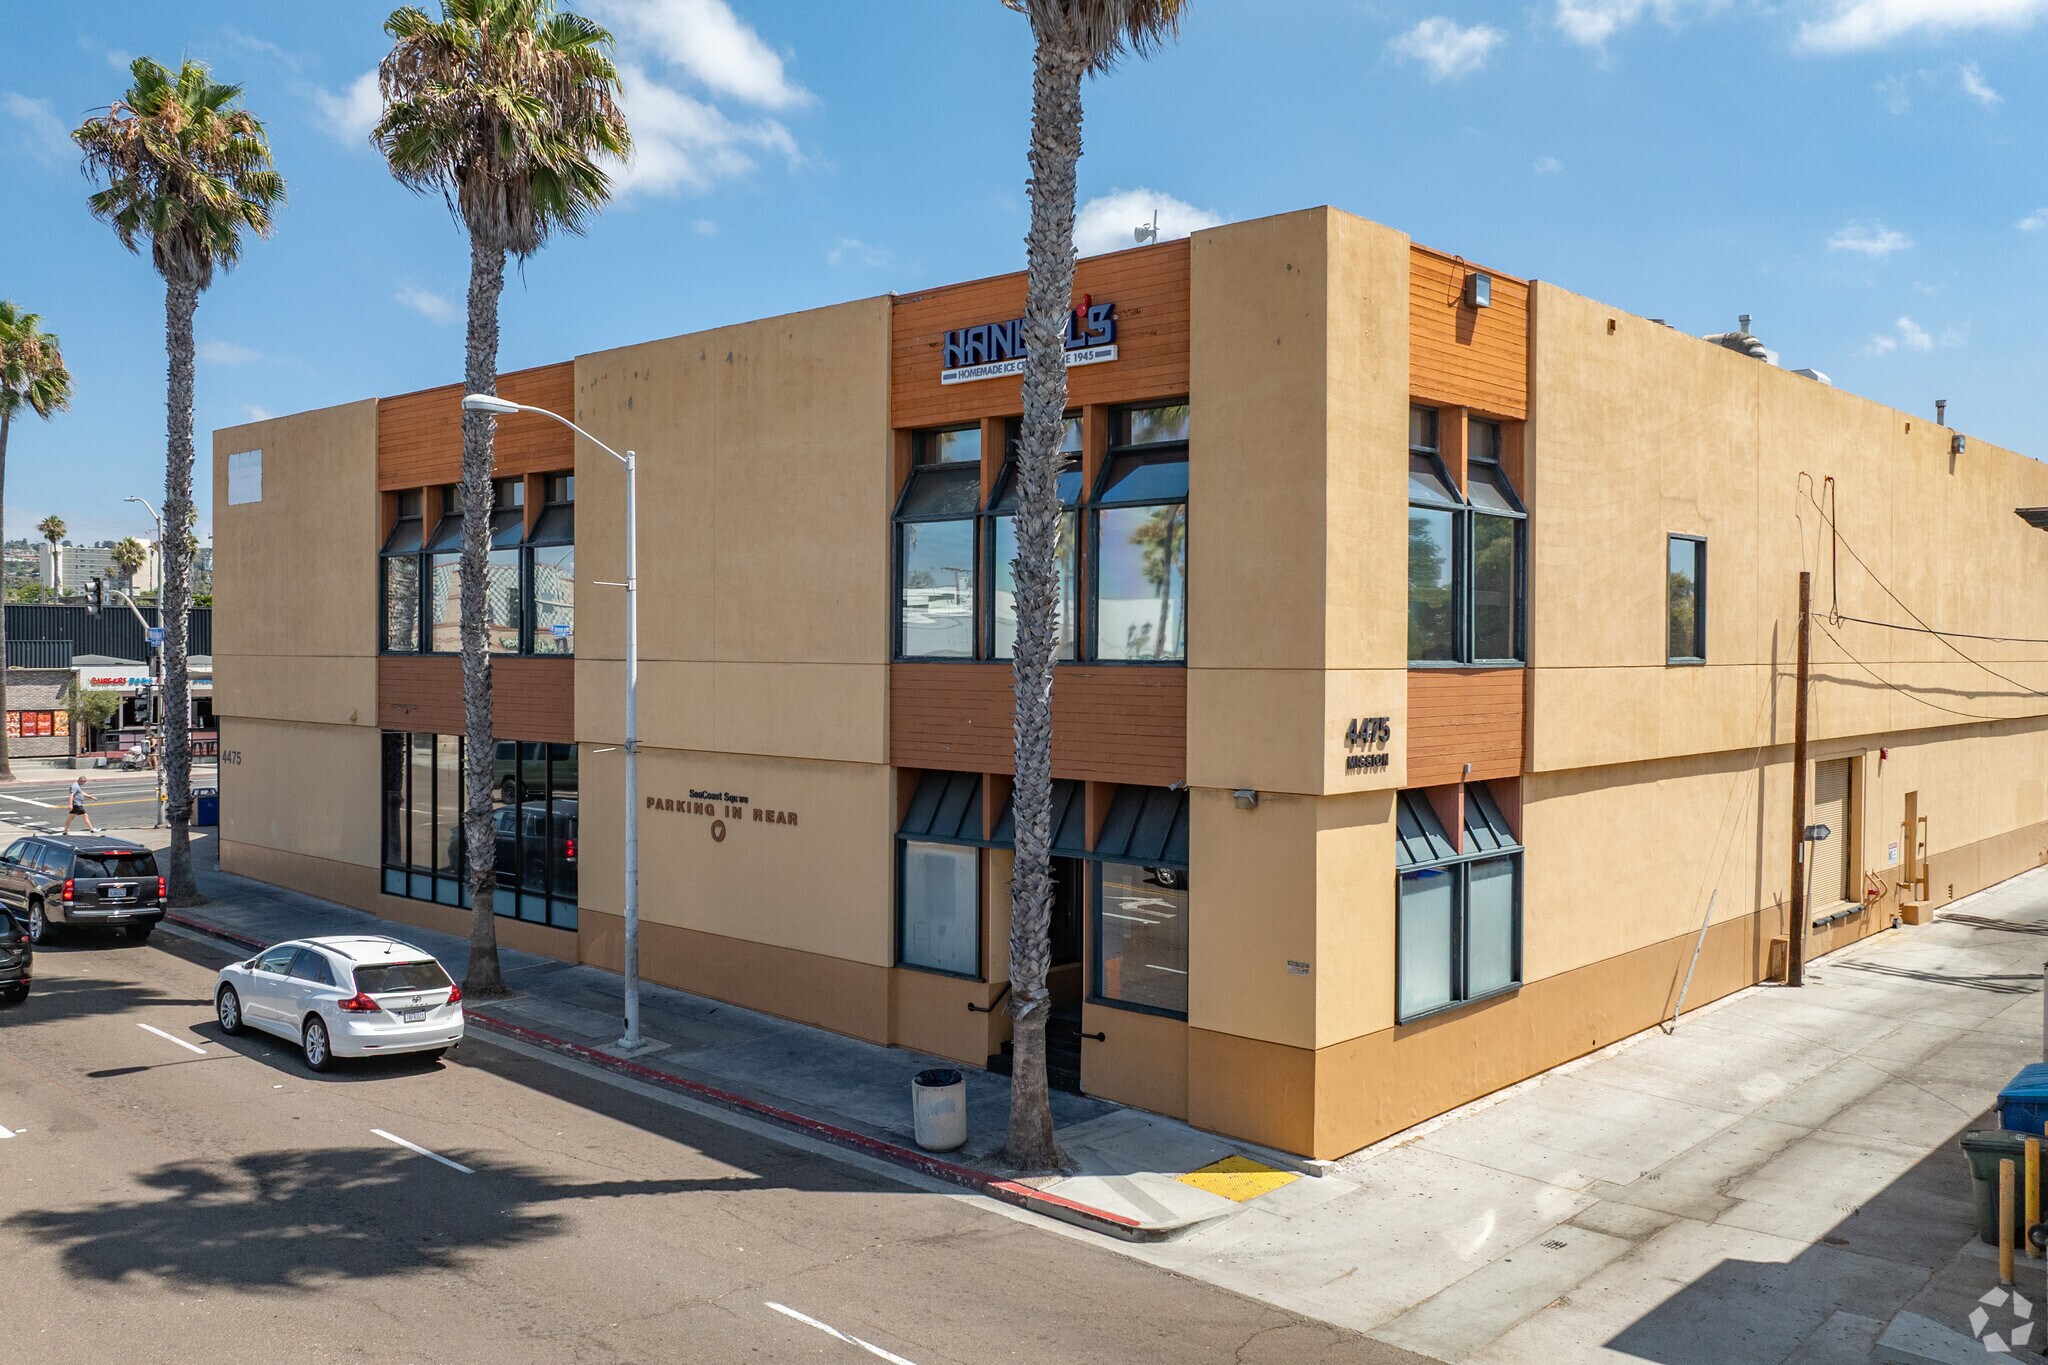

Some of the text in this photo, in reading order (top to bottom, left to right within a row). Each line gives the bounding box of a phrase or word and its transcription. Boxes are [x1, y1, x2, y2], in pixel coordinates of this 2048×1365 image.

[943, 294, 1116, 368] HANDL'S
[958, 364, 1003, 380] HOMEMADE
[1004, 362, 1015, 373] ICE
[1073, 351, 1094, 363] 1945
[1345, 716, 1391, 745] 4475
[222, 750, 242, 765] 4475
[1346, 753, 1389, 770] MISSION
[689, 789, 722, 801] SeaCoast
[646, 797, 798, 826] PARKING IN REAR
